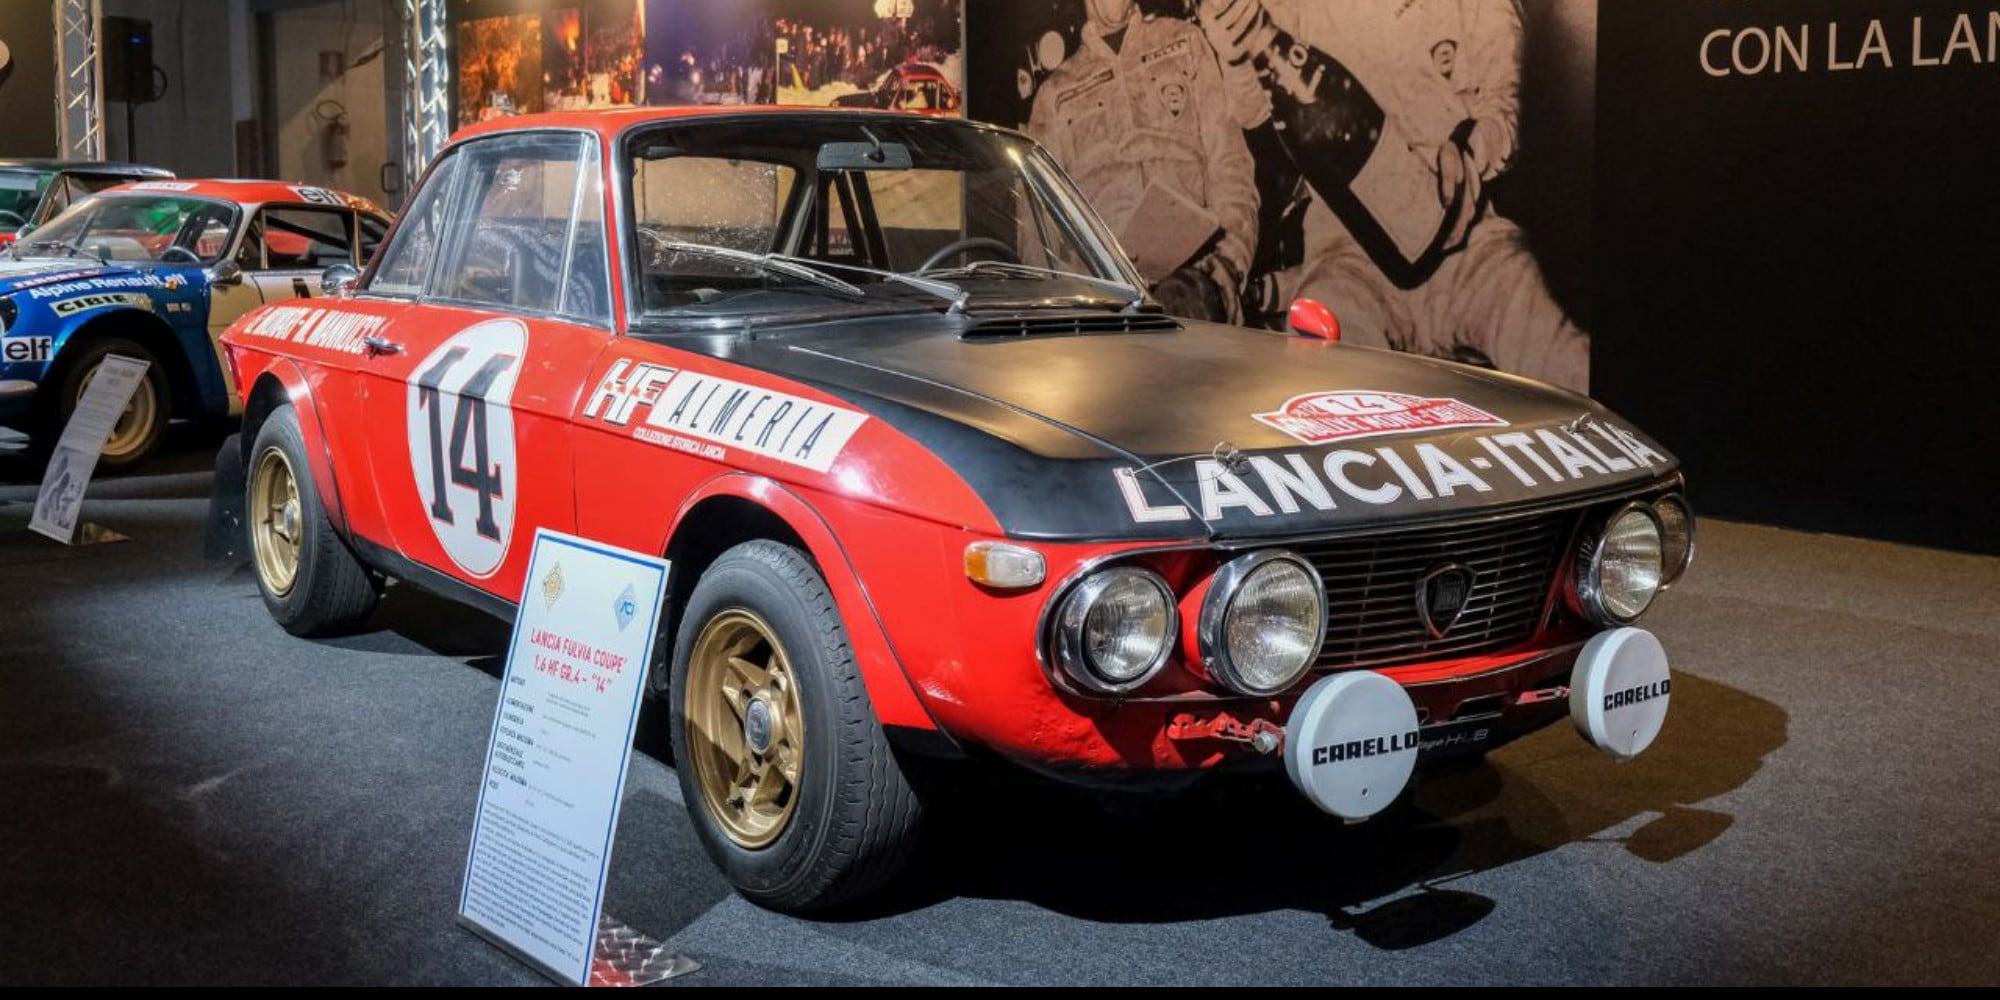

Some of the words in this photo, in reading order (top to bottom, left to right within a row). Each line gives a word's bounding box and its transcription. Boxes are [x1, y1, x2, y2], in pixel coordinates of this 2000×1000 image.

[1700, 24, 1809, 77] CON
[1827, 19, 1893, 70] LA
[30, 280, 91, 299] Alpine
[5, 338, 51, 361] elf
[582, 357, 679, 427] HF
[669, 379, 835, 460] ALMERIA
[1325, 396, 1385, 413] 14
[418, 345, 516, 544] 14
[531, 627, 561, 653] LANCIA
[562, 638, 592, 661] FULVIA
[534, 653, 547, 672] 1.6
[547, 658, 560, 676] HF
[1604, 679, 1671, 712] CARELLO
[1312, 730, 1419, 766] CARELLO
